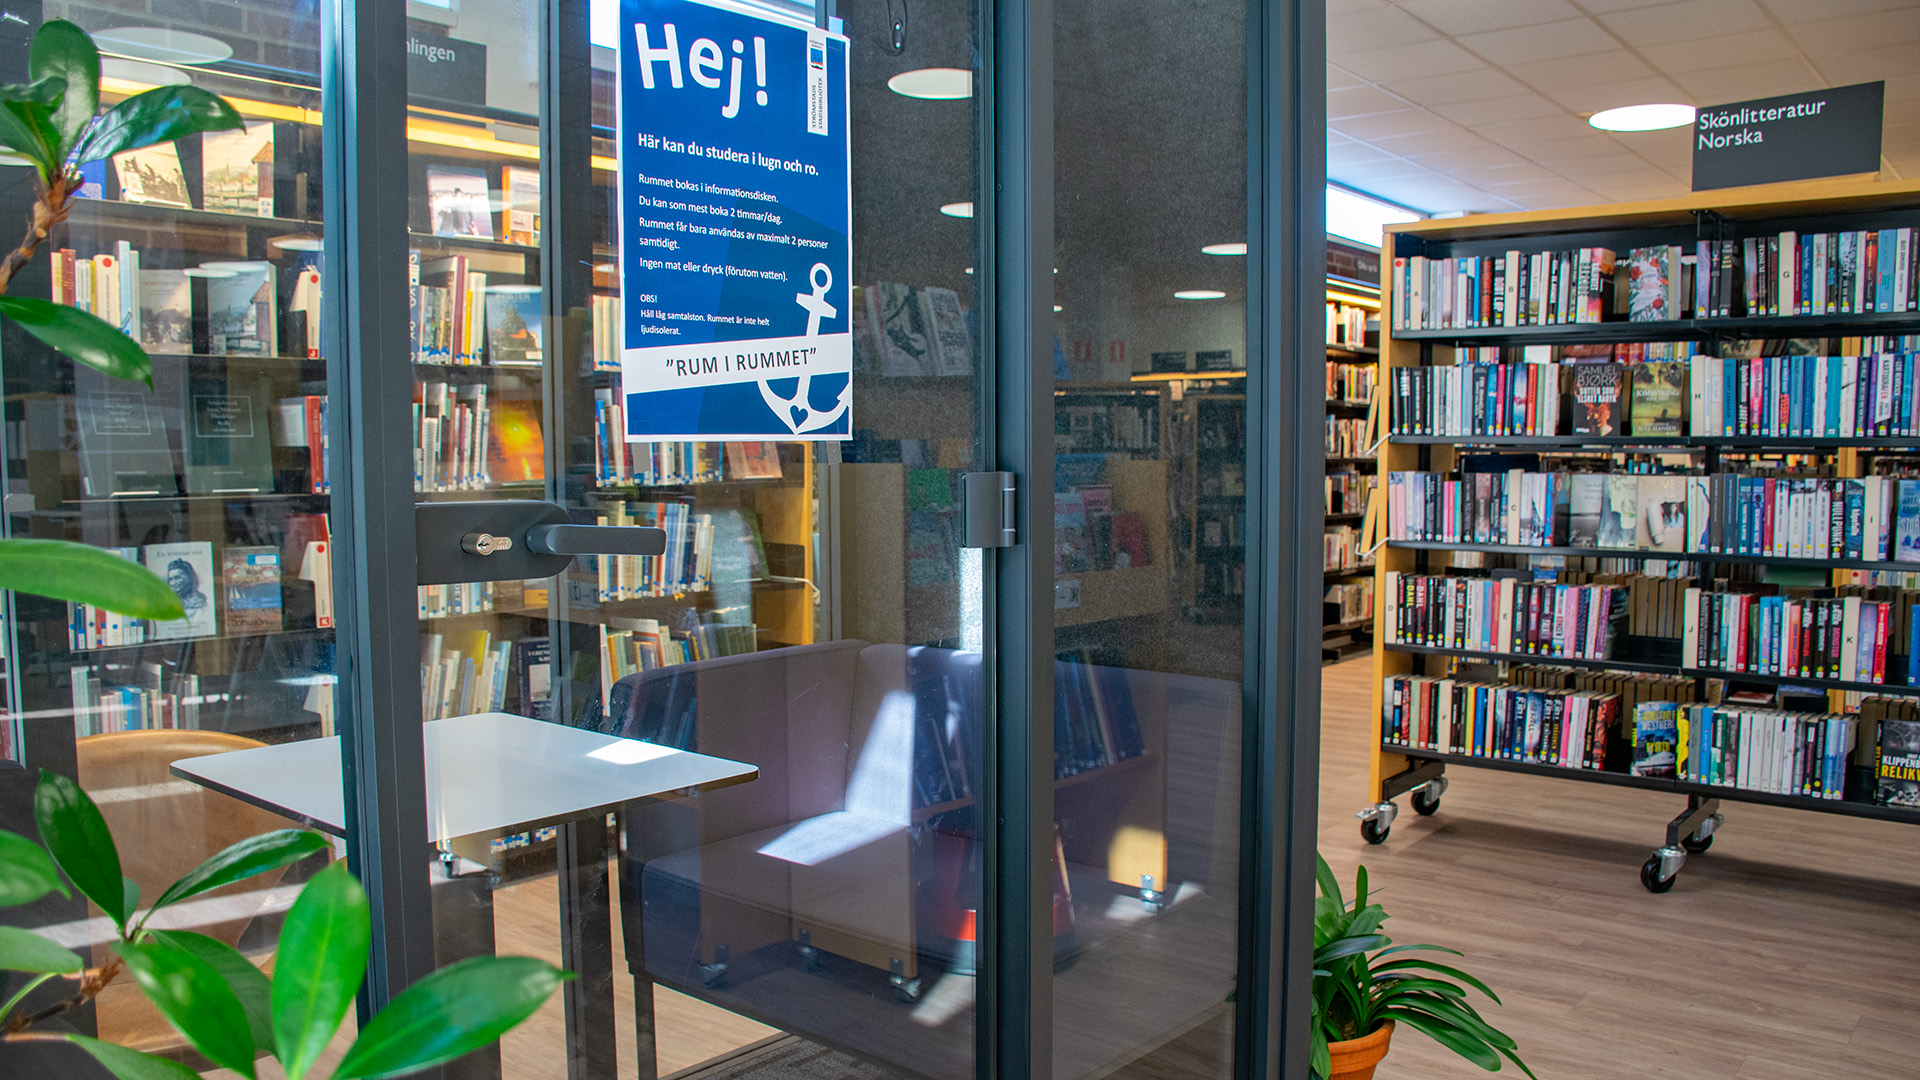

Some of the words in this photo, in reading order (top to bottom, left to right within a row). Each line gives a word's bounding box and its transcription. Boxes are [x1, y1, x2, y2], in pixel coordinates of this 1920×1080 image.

[634, 22, 768, 118] Hej!
[1699, 101, 1826, 130] Skönlitteratur
[1698, 128, 1764, 150] Norska
[638, 132, 660, 149] Här
[663, 136, 684, 153] kan
[687, 141, 703, 156] du
[706, 146, 749, 163] studera
[752, 151, 755, 165] i
[758, 152, 781, 170] lugn
[783, 159, 802, 173] och
[805, 164, 818, 175] ro.
[638, 173, 673, 188] Rummet
[675, 178, 699, 191] bokas
[700, 182, 703, 191] i
[705, 183, 779, 203] informationsdisken.
[639, 195, 651, 206] Du
[652, 196, 667, 208] kan
[669, 201, 686, 210] som
[688, 204, 708, 214] mest
[709, 204, 728, 216] boka
[730, 207, 735, 217] 2
[736, 209, 782, 225] timmar/dag.
[639, 217, 674, 230] Rummet
[676, 221, 687, 231] får
[689, 222, 707, 234] bara
[708, 227, 745, 239] användas
[756, 233, 790, 244] maximalt
[791, 235, 796, 245] 2
[797, 238, 828, 249] personer
[639, 237, 680, 251] samtidigt.
[639, 257, 663, 270] Ingen
[665, 262, 681, 270] mat
[682, 261, 701, 272] eller
[702, 263, 723, 275] dryck
[725, 265, 759, 277] (förutom
[760, 271, 788, 282] vatten).
[640, 293, 657, 303] OBS!
[640, 309, 654, 318] Håll
[655, 310, 666, 320] låg
[667, 312, 705, 321] samtalston.
[707, 314, 735, 323] Rummet
[744, 316, 756, 325] inte
[757, 317, 769, 326] helt
[640, 324, 681, 335] ljudisolerat.
[666, 357, 718, 376] ”RUM
[725, 356, 729, 372] I
[737, 347, 816, 371] RUMMET”
[1577, 365, 1618, 375] SAMUEL
[1577, 374, 1617, 386] BJØRK
[1831, 501, 1844, 547] NULLPUNKT
[1406, 585, 1415, 608] DAHL
[1416, 585, 1424, 608] DAHL
